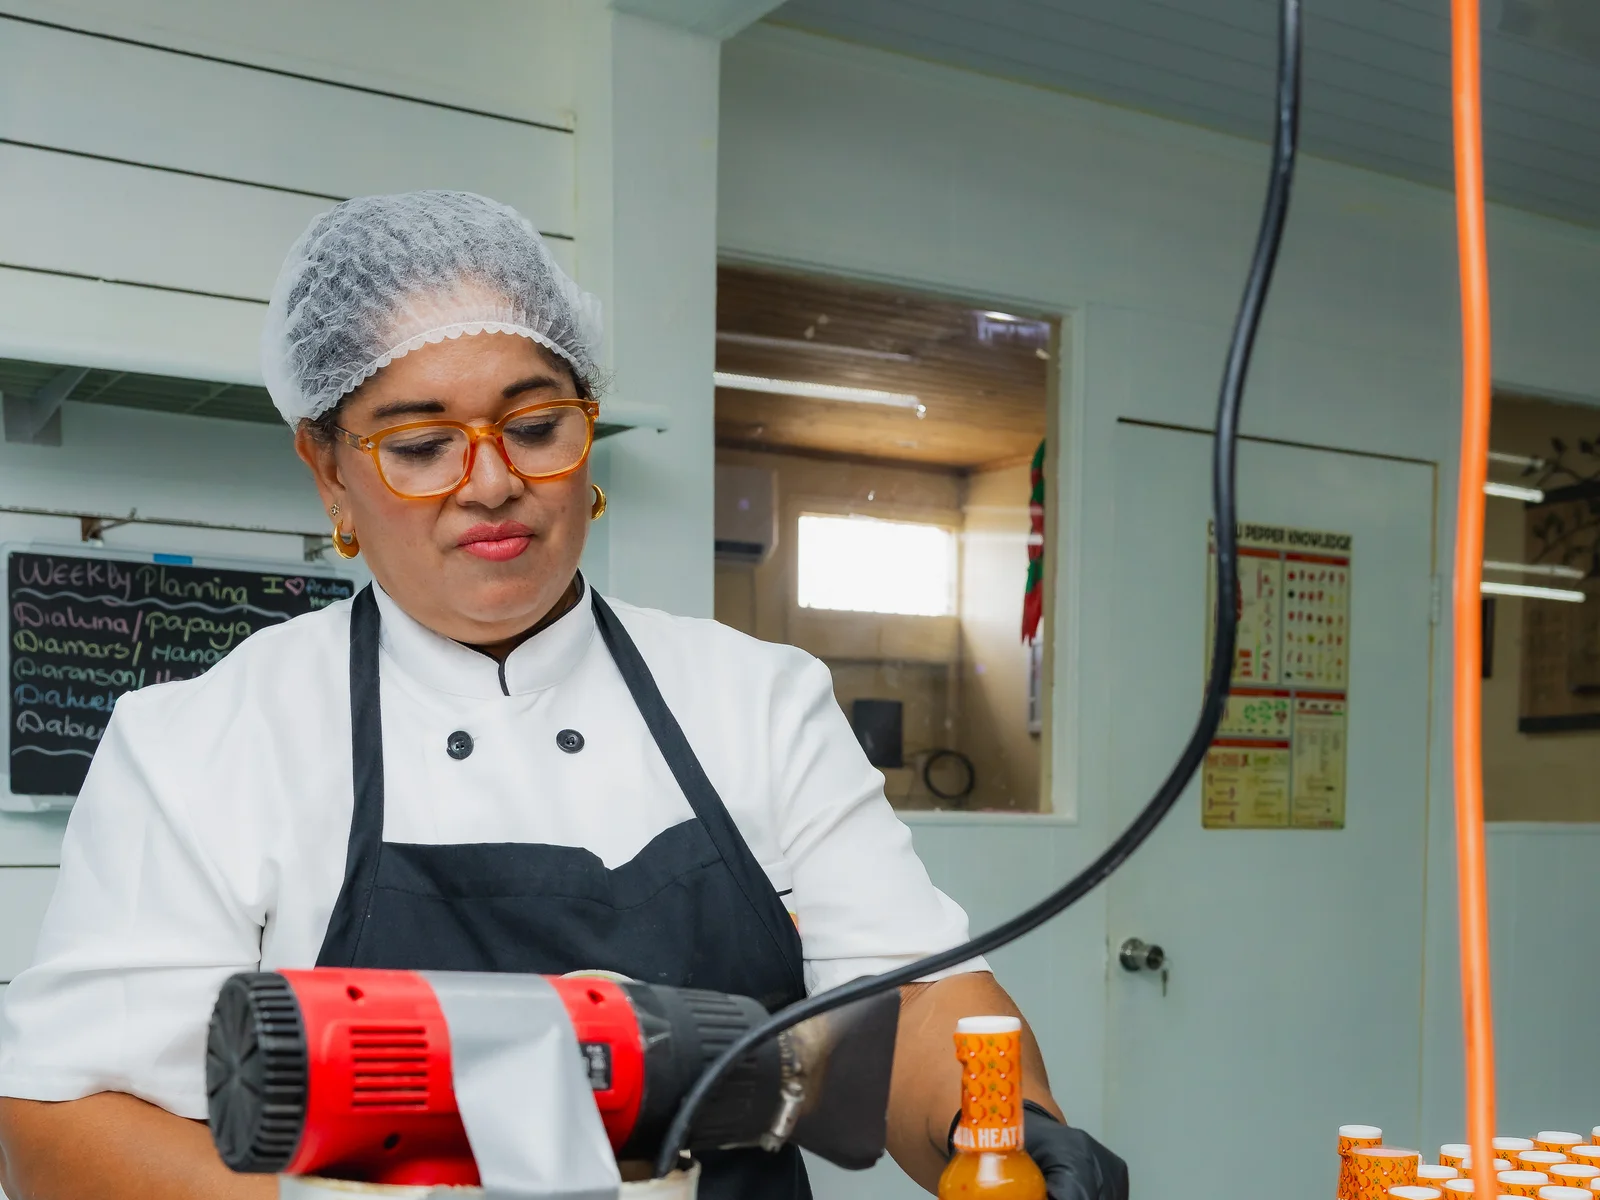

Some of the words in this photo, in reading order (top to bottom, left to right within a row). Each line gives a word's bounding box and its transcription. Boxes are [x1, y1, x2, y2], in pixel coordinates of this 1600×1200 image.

[1245, 525, 1285, 543] PEPPER
[1288, 527, 1352, 551] KNOWLEDGE
[978, 1126, 1017, 1149] HEAT
